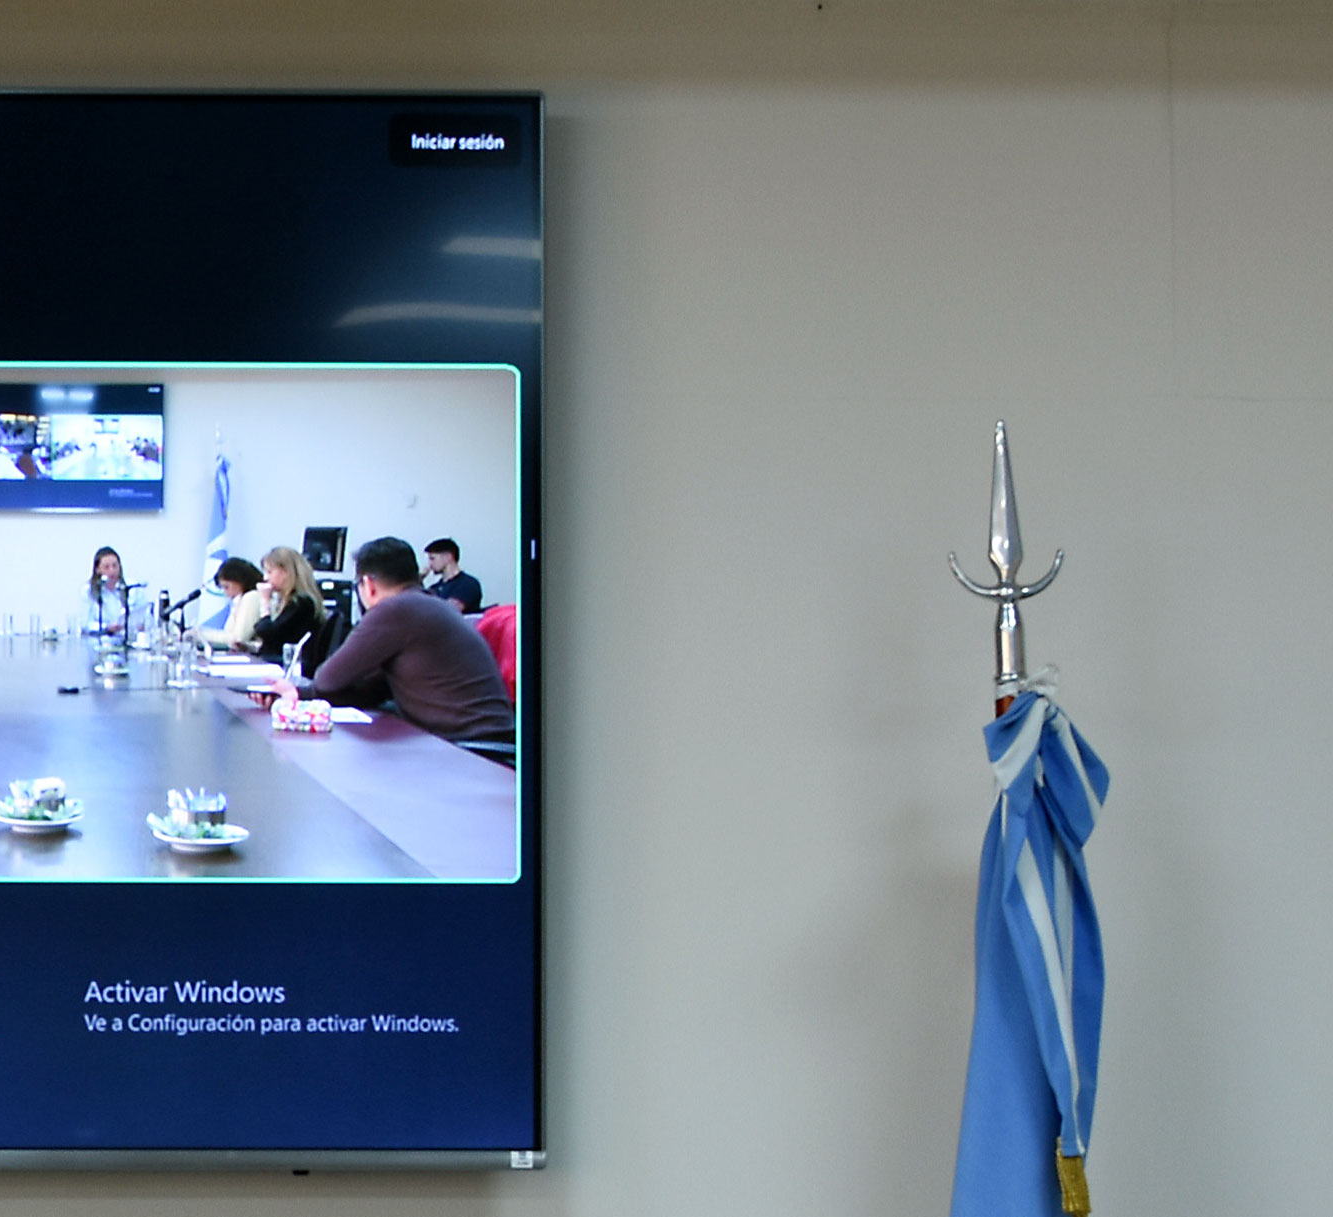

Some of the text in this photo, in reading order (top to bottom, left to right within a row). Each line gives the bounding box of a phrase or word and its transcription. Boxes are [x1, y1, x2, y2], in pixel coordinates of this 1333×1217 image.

[410, 132, 505, 150] Iniciar sesión
[84, 979, 286, 1004] Activar Windows
[83, 1012, 459, 1036] Ve a Configuración para activar Windows.
